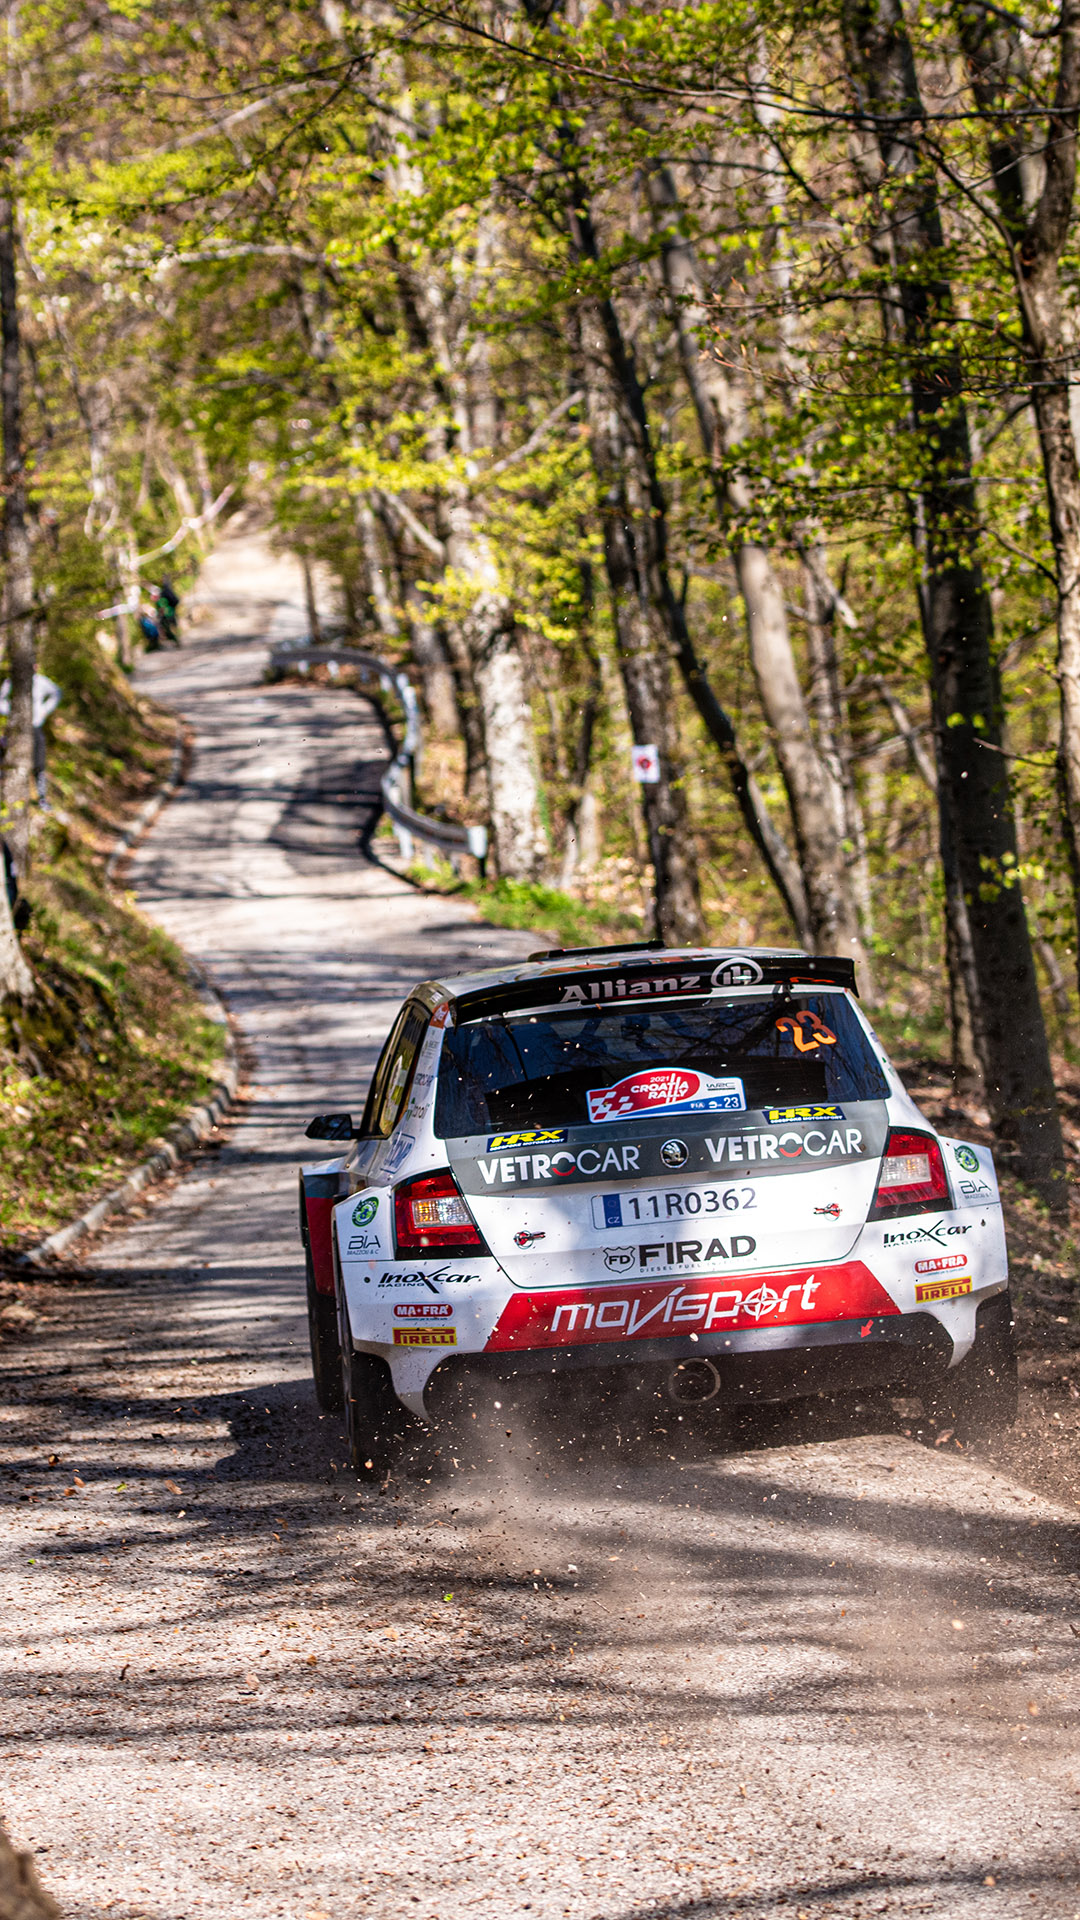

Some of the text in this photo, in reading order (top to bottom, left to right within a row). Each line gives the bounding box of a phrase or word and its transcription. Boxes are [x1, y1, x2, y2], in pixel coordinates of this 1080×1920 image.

[559, 975, 700, 1003] Allianz
[776, 1010, 837, 1052] 23
[630, 1077, 689, 1093] CROATIA
[648, 1088, 688, 1101] RALLY
[724, 1097, 739, 1108] 23
[769, 1106, 837, 1120] HRX
[490, 1129, 564, 1147] HRX
[704, 1128, 863, 1162] VETROCAR
[477, 1146, 640, 1185] VETROCAR
[958, 1179, 992, 1194] BIA
[628, 1187, 758, 1219] 11R0362
[608, 1216, 620, 1225] CZ
[348, 1235, 381, 1249] BIA
[883, 1239, 931, 1249] RACING
[639, 1235, 757, 1267] FIRAD
[609, 1255, 631, 1266] FD
[640, 1265, 673, 1273] DIESEL
[915, 1277, 971, 1302] PIRELLI
[394, 1328, 455, 1344] PIRELLI
